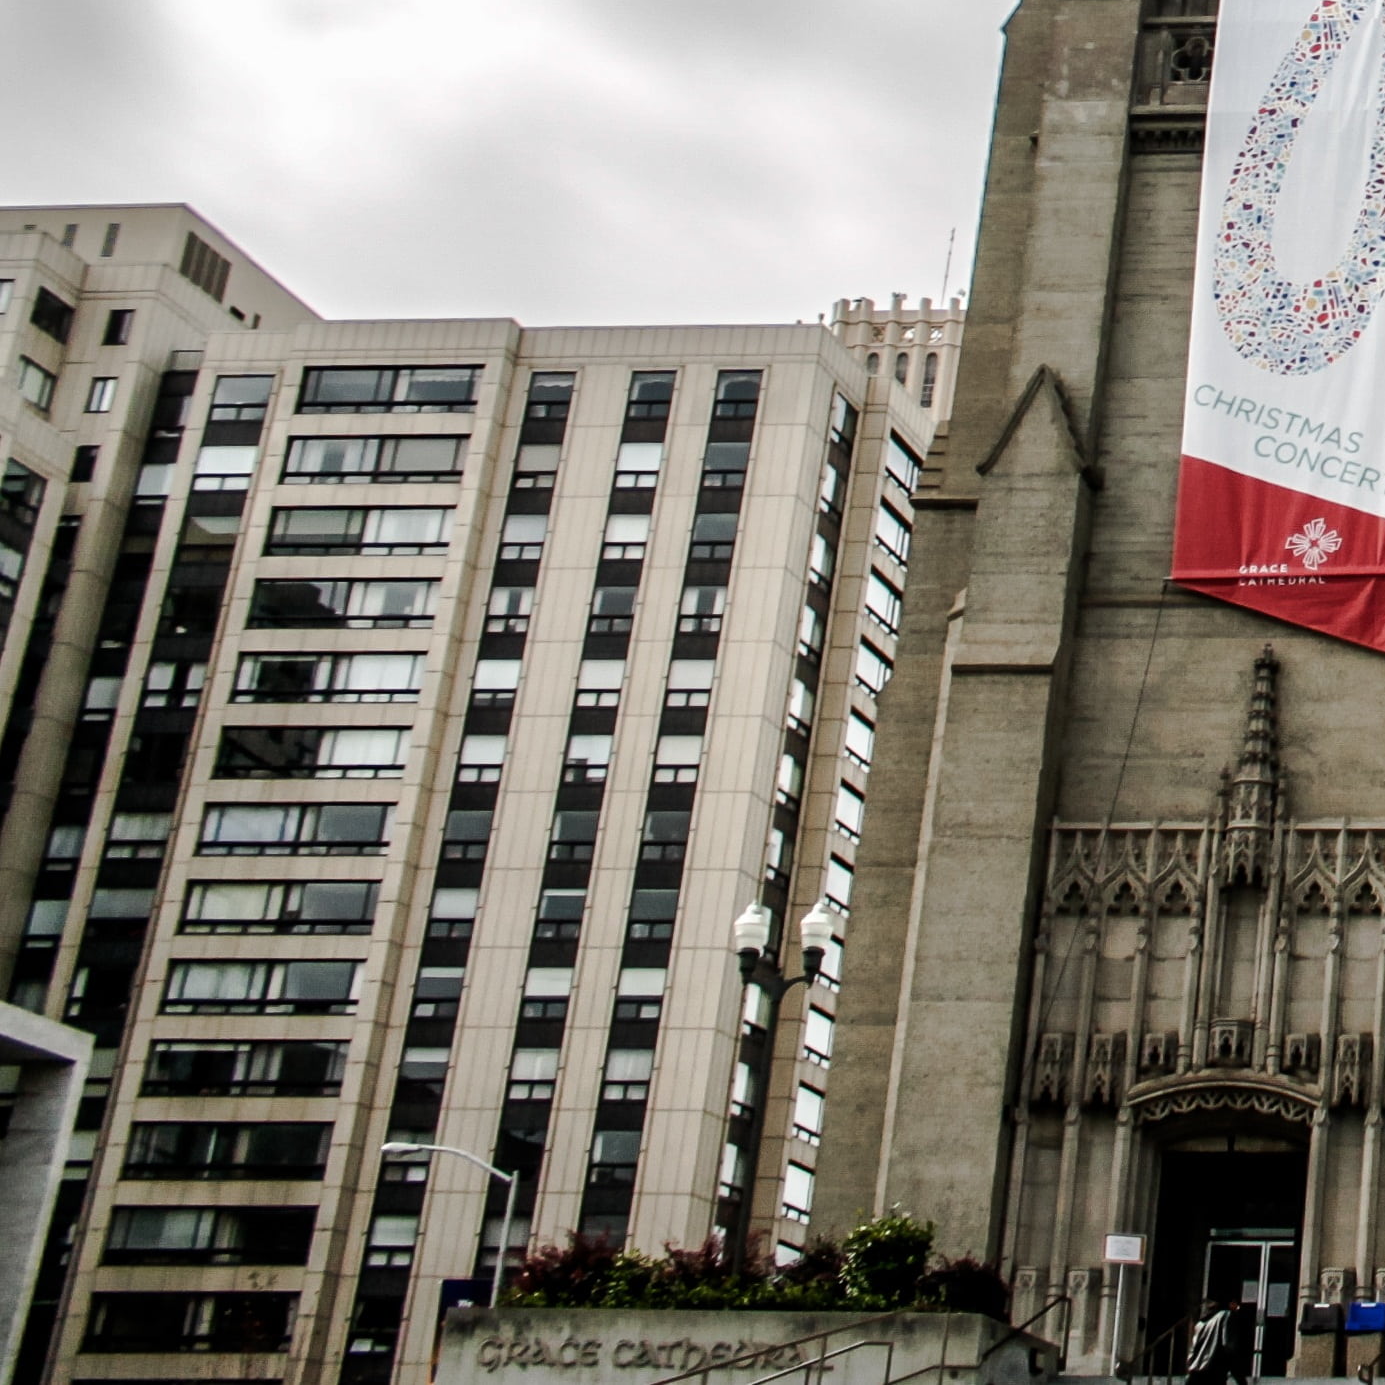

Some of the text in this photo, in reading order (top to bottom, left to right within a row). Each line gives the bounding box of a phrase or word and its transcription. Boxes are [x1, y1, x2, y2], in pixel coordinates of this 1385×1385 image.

[1194, 384, 1364, 454] CHRISTMAS
[1239, 564, 1288, 574] GRACE
[477, 1336, 602, 1373] GRACE
